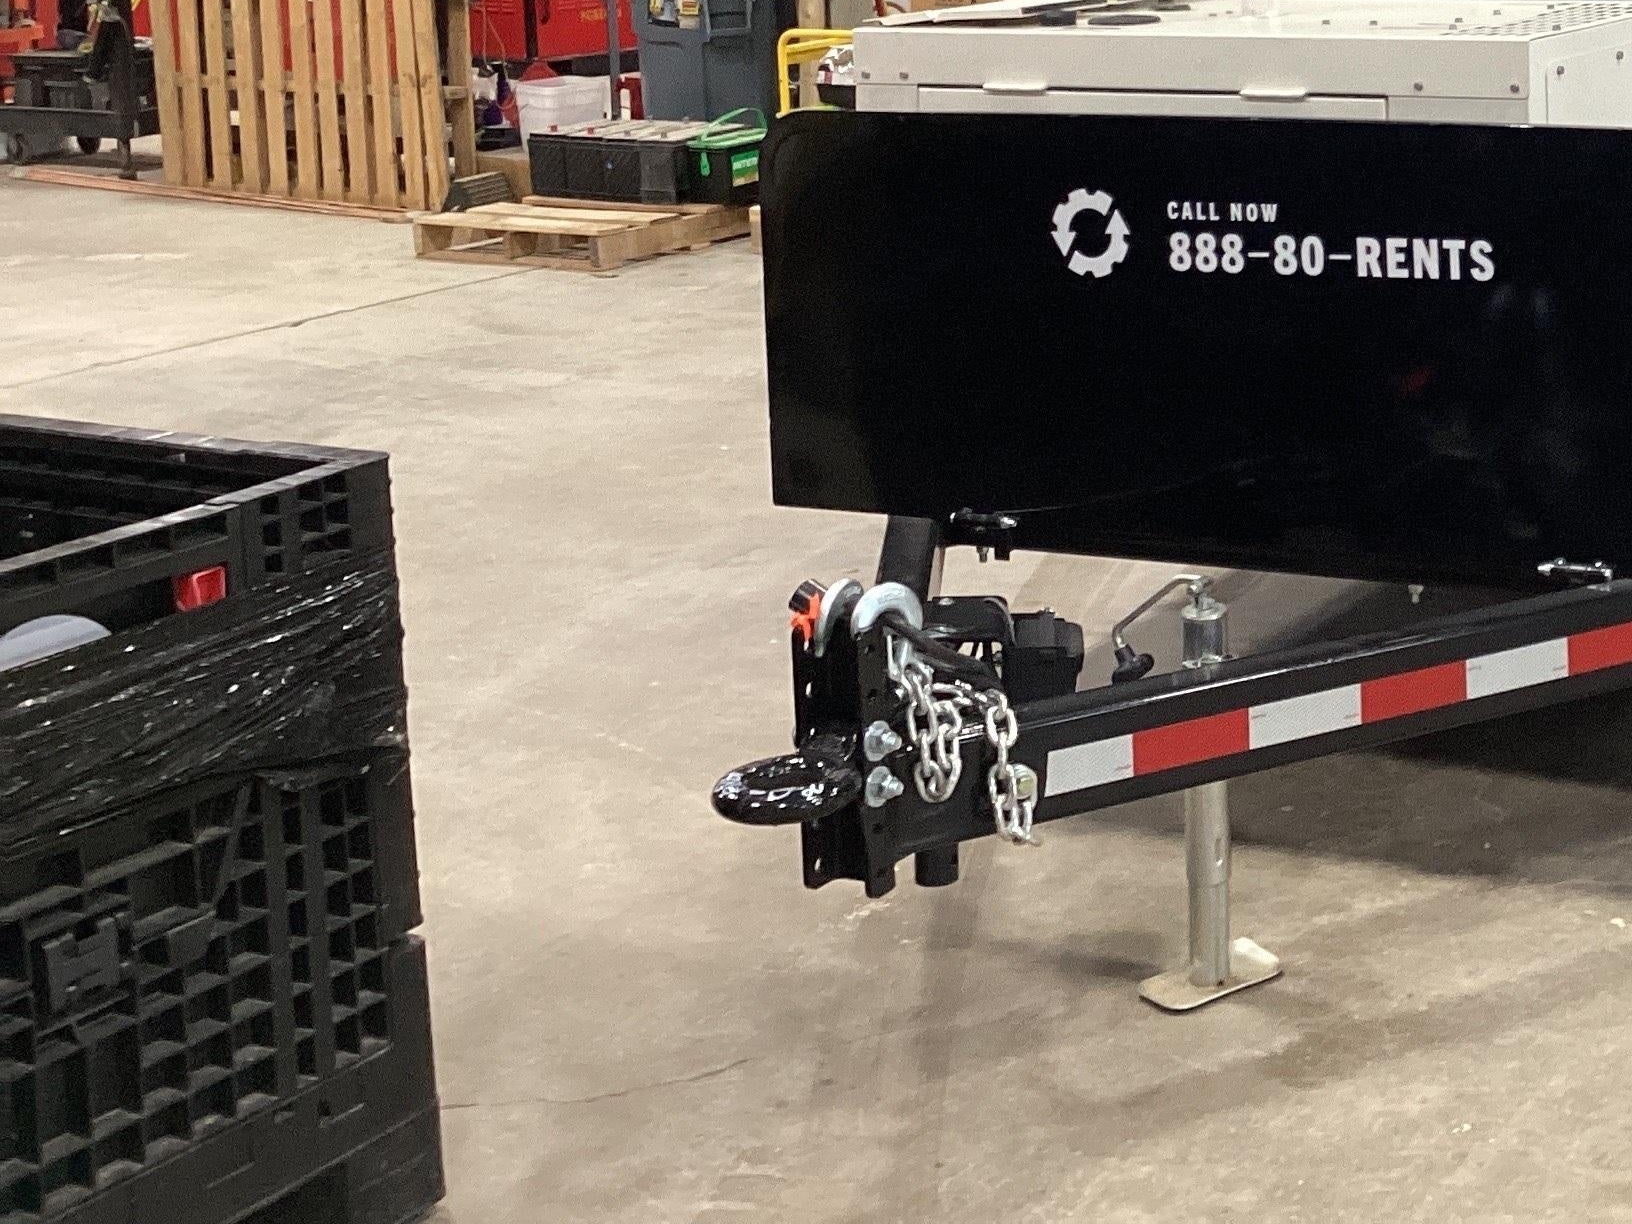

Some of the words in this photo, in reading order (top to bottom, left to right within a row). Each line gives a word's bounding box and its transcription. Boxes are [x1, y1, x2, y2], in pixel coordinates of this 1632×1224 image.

[1167, 201, 1220, 222] CALL
[1229, 202, 1279, 224] NOW
[1169, 231, 1496, 283] 888-80-RENTS
